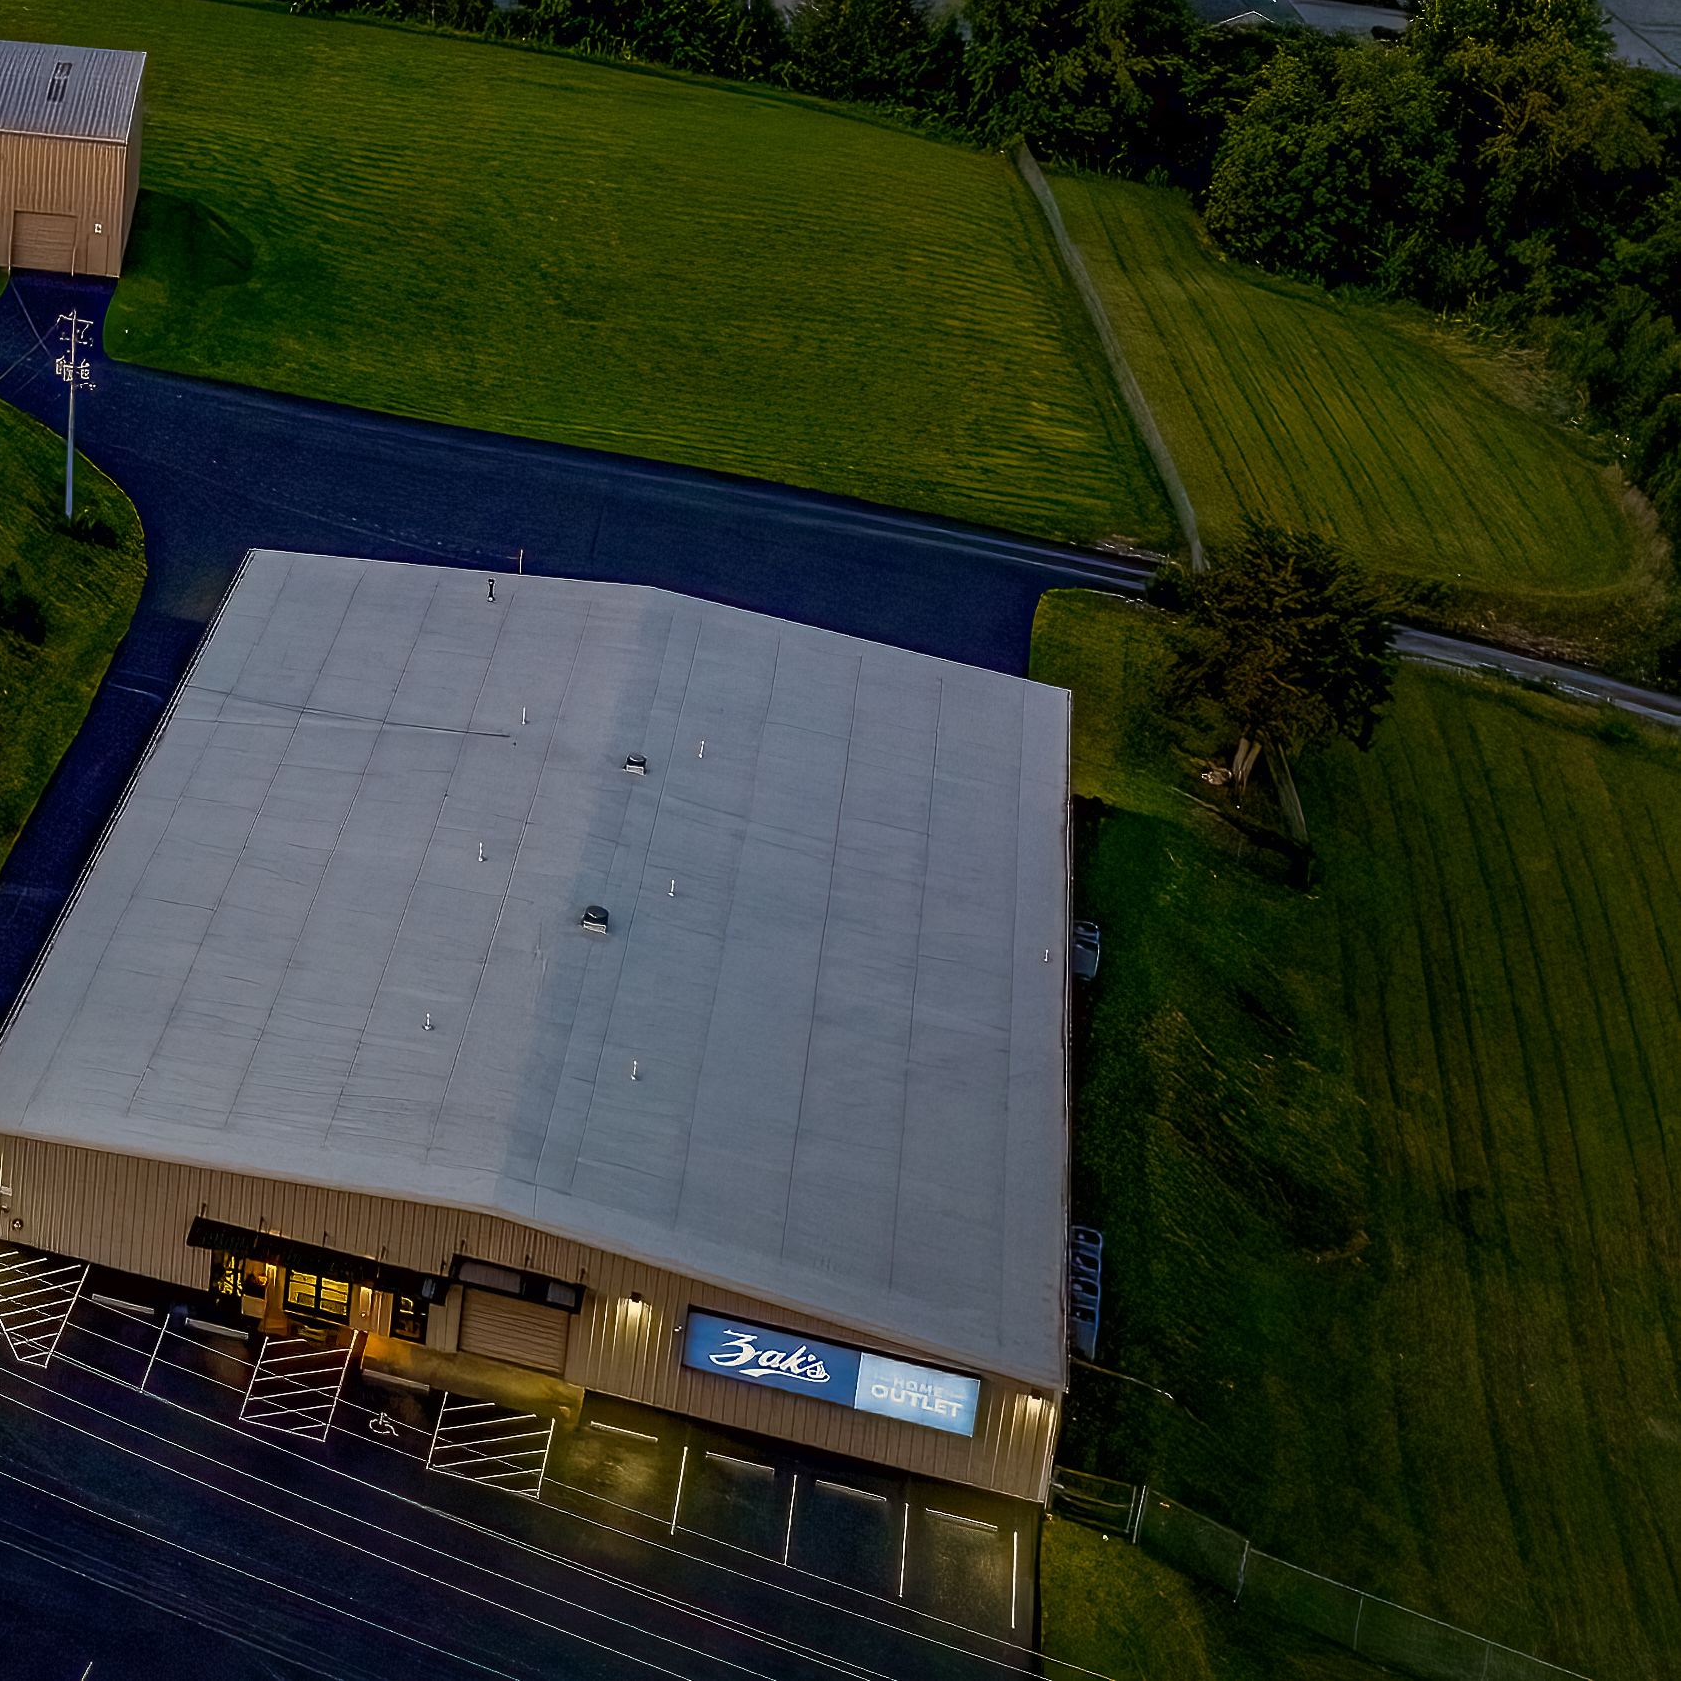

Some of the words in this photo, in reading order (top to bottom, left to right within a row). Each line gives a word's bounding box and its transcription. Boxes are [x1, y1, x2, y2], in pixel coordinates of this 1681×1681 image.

[708, 1329, 831, 1383] Zak's
[870, 1383, 964, 1418] OUTLET
[893, 1375, 946, 1400] HOME
